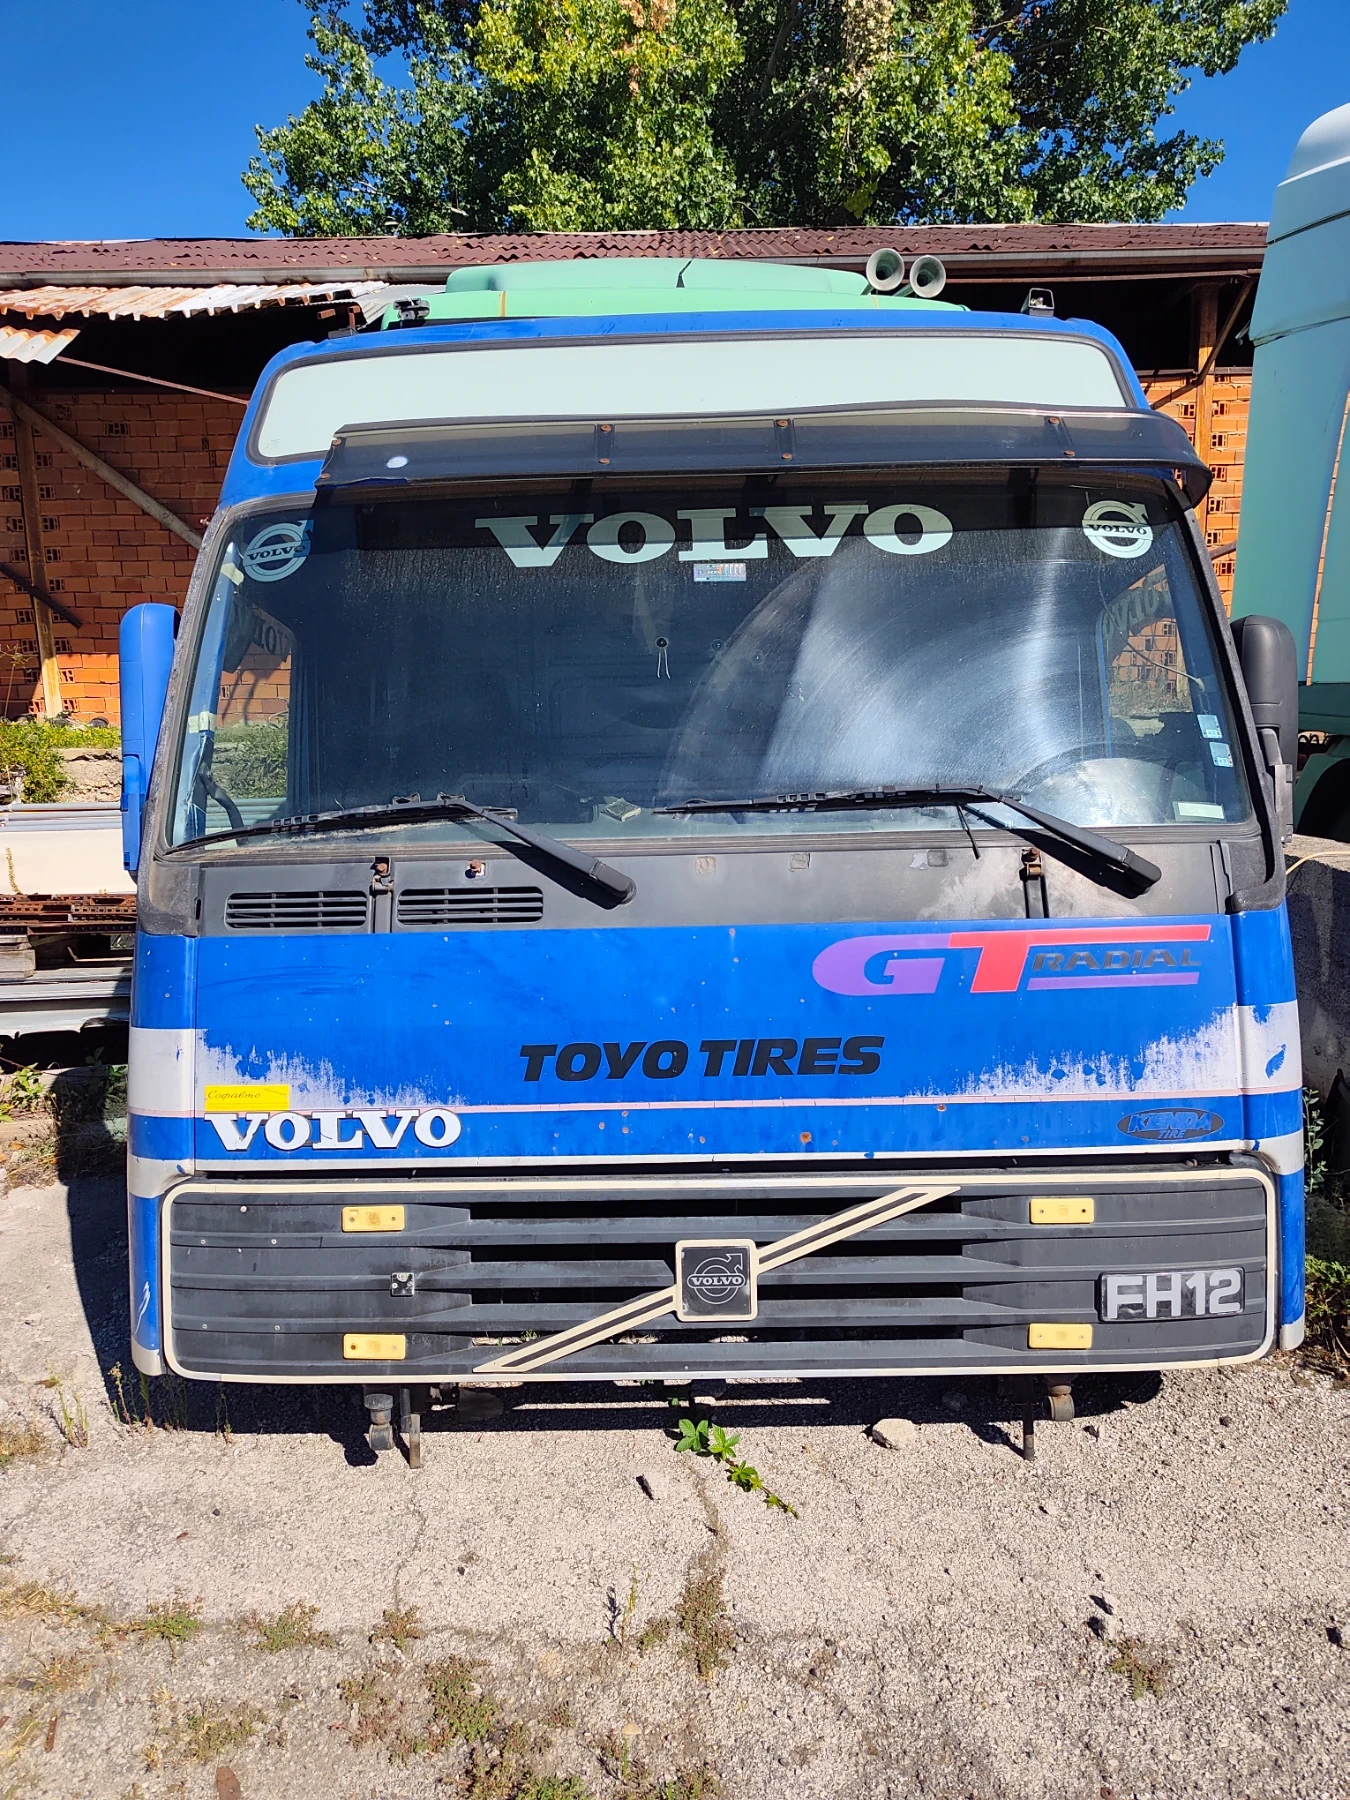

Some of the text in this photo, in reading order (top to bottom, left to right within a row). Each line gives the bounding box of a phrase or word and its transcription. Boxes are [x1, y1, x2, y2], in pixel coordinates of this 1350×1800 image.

[475, 504, 954, 568] VOLVO
[1086, 524, 1147, 535] VOLVO
[247, 545, 306, 561] VOLVO
[812, 925, 1060, 996] GT
[1031, 948, 1202, 972] RADIAL
[519, 1035, 885, 1082] TOYO TIRES
[204, 1108, 462, 1151] VOLVO
[1127, 1111, 1212, 1133] KENDA
[1157, 1129, 1188, 1139] TIRE
[691, 1276, 742, 1286] VOLVO
[1106, 1268, 1241, 1319] FH12
